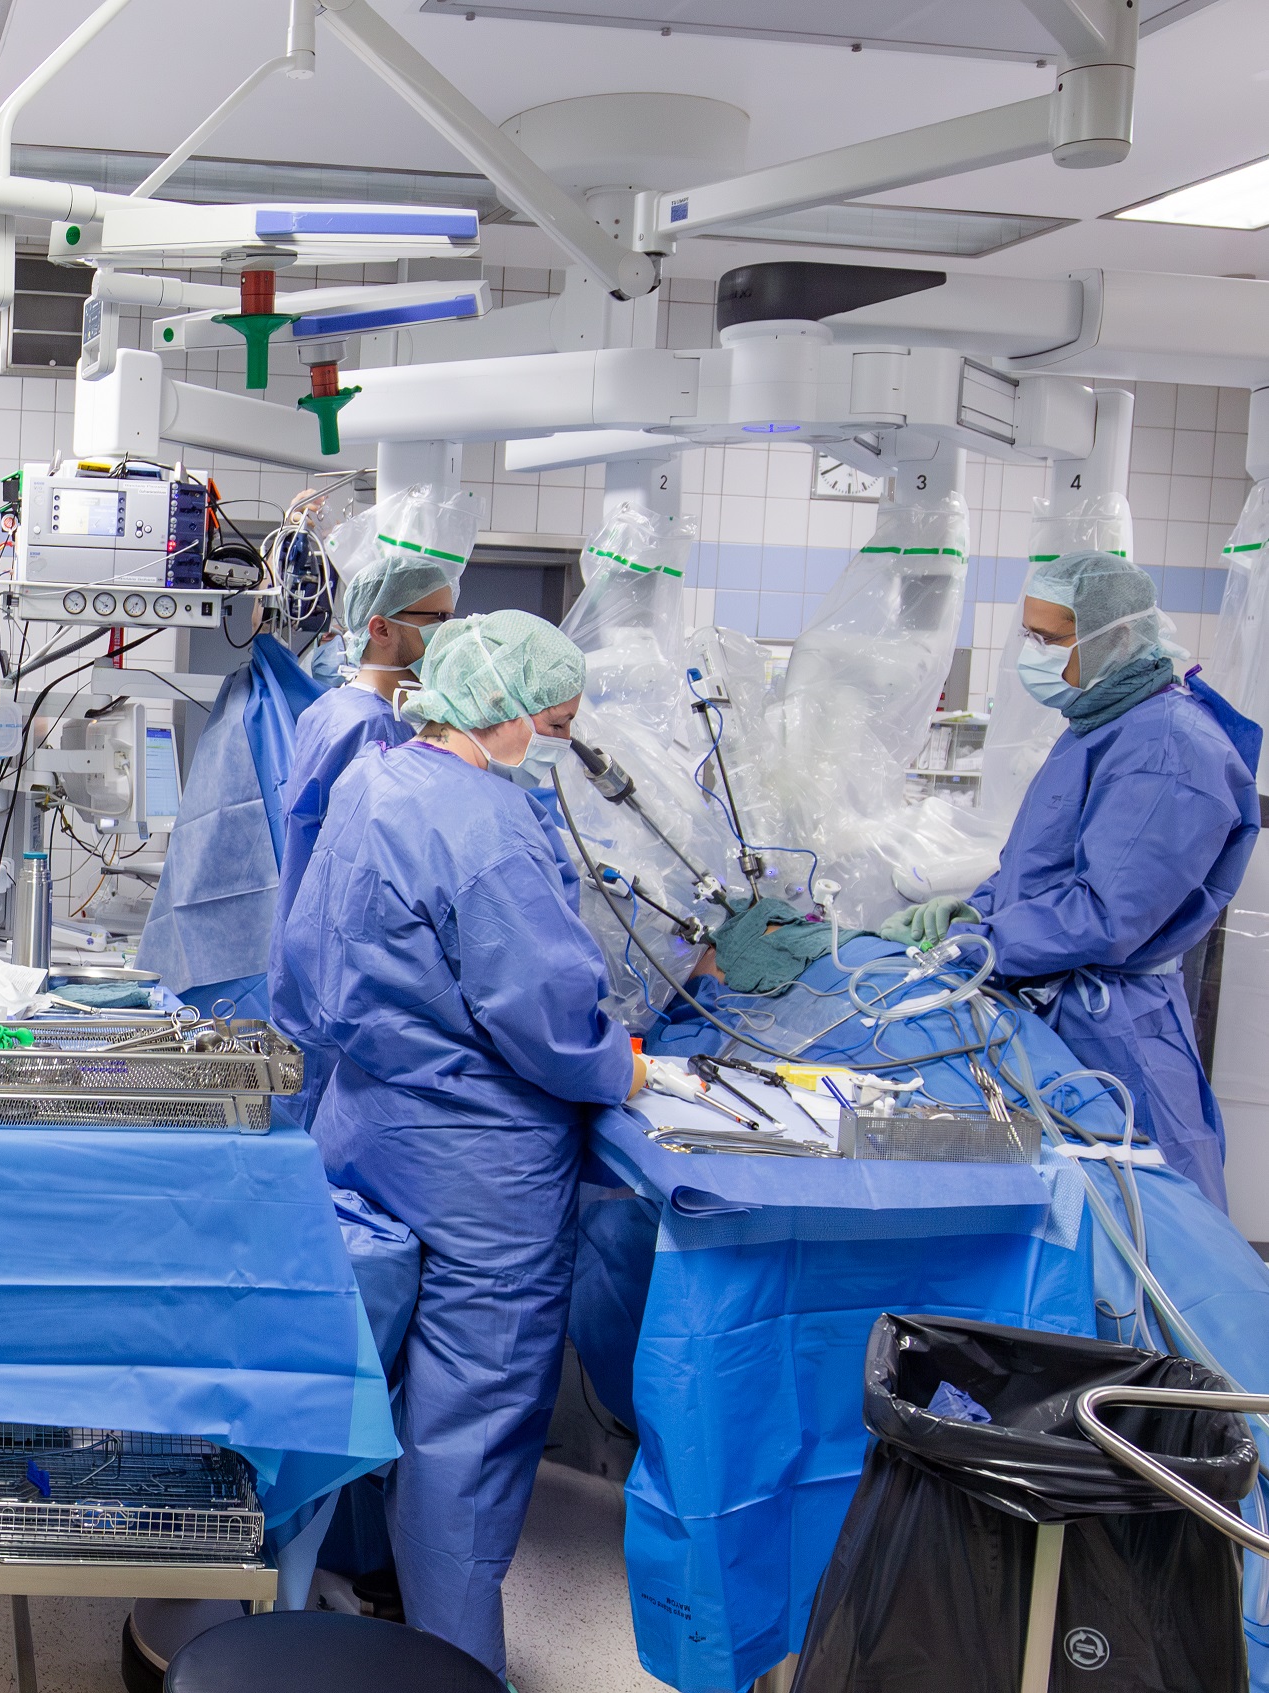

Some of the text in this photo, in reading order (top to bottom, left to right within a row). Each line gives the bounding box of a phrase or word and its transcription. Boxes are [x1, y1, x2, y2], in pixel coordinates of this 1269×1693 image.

[660, 475, 667, 490] 2
[917, 475, 926, 490] 3
[1070, 474, 1081, 490] 4
